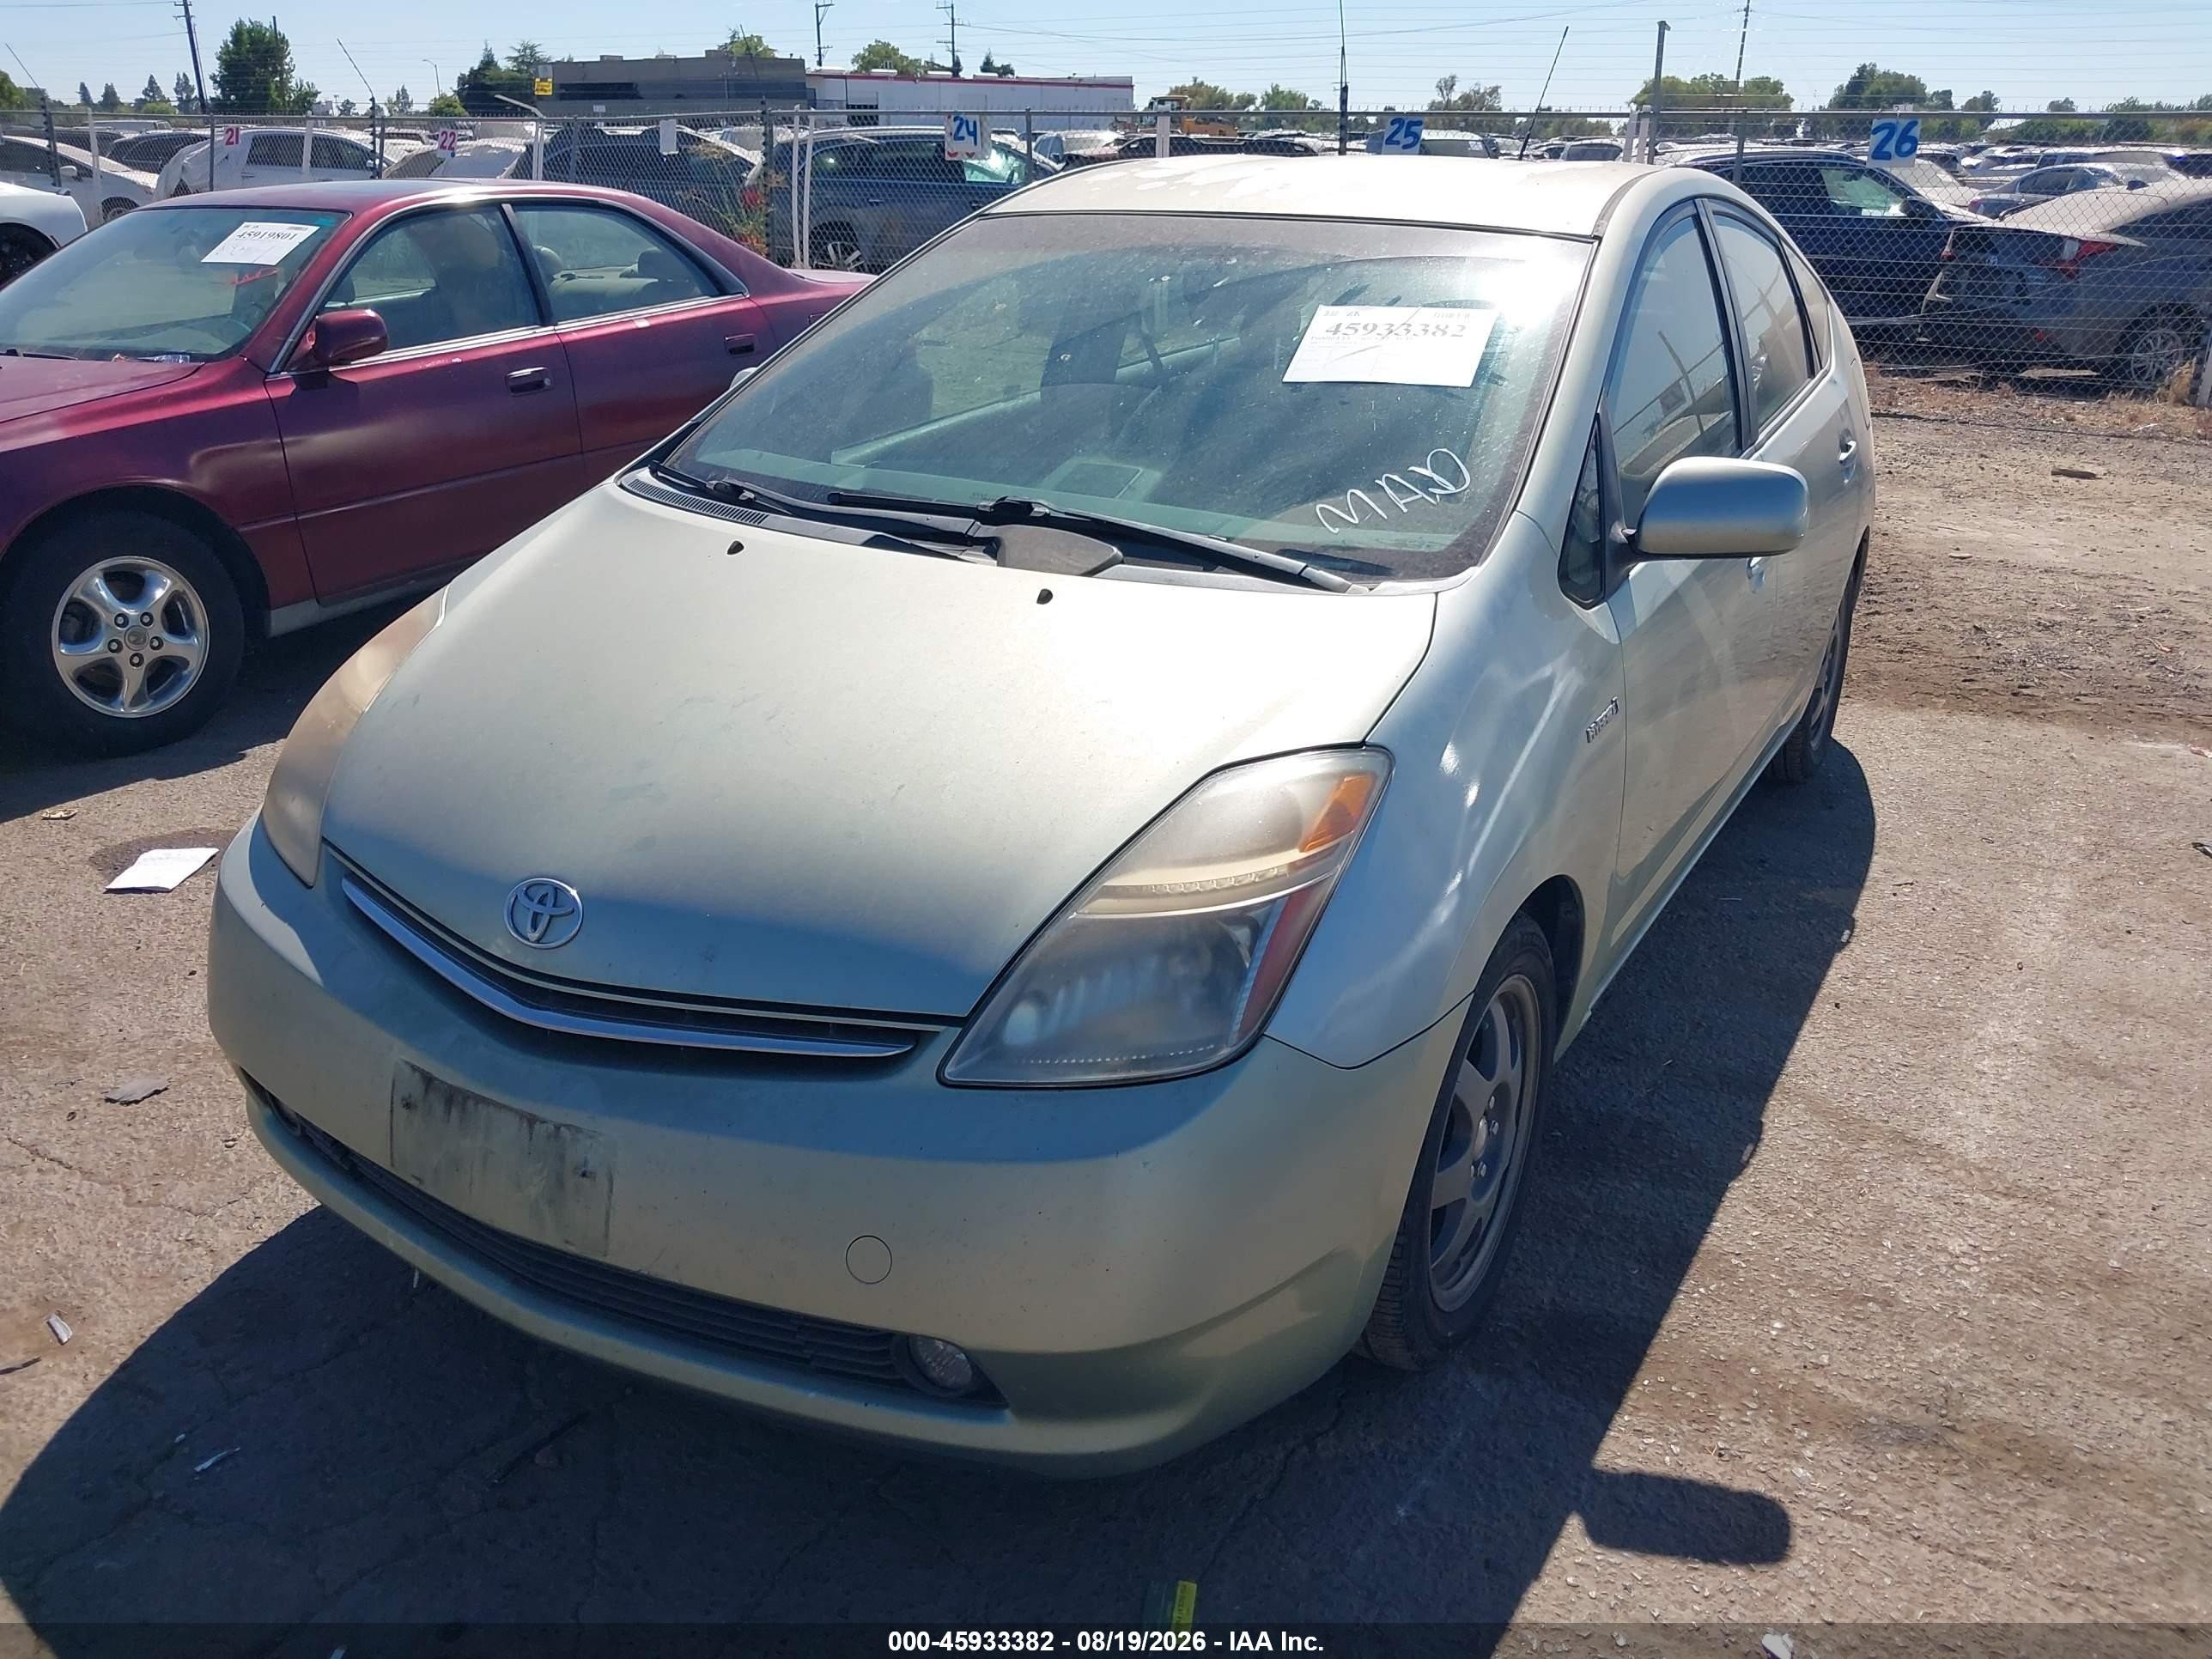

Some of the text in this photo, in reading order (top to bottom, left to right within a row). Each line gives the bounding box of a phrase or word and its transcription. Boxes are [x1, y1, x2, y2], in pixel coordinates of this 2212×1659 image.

[225, 127, 240, 146] 21
[440, 130, 456, 151] 22
[953, 115, 977, 146] 24
[1385, 117, 1423, 149] 25
[1871, 120, 1918, 161] 26
[236, 230, 299, 240] 45919801
[1325, 322, 1467, 337] 45933382
